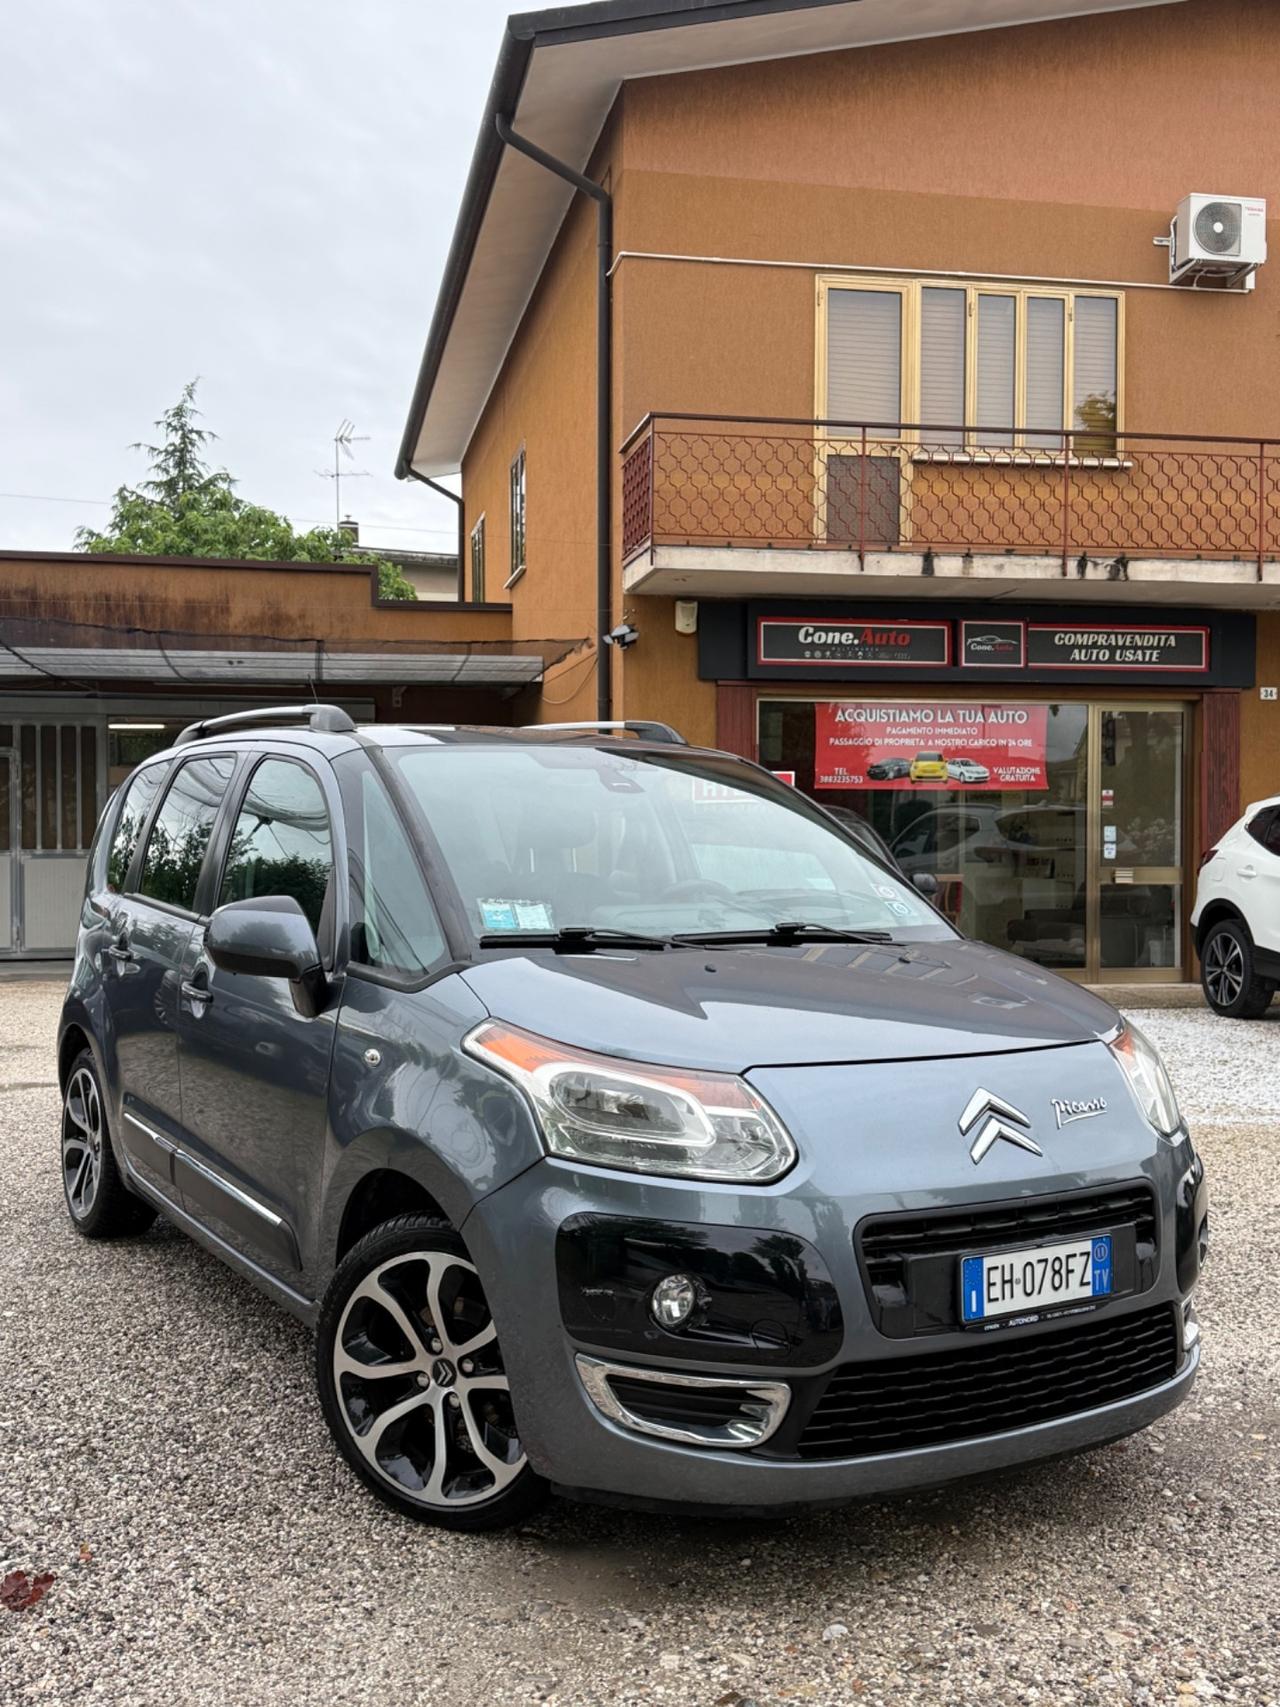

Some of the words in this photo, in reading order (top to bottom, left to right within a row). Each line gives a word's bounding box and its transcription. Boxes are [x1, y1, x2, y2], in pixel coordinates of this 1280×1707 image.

[1054, 633, 1176, 647] COMPRAVENDITA
[1070, 649, 1110, 661] AUTO
[1114, 649, 1160, 662] USATE
[1263, 689, 1274, 698] 34
[835, 708, 934, 723] ACQUISTIAMO
[937, 710, 954, 723] LA
[957, 710, 985, 723] TUA
[988, 710, 1028, 724] AUTO
[886, 726, 934, 736] PAGAMENTO
[935, 726, 978, 736] IMMEDIATO
[829, 737, 873, 746] PASSAGGIO
[874, 737, 883, 746] DI
[927, 739, 934, 747] A
[935, 738, 967, 747] NOSTRO
[968, 739, 997, 747] CARICO
[998, 739, 1007, 747] IN
[1008, 739, 1017, 747] 24
[1017, 739, 1033, 748] ORE
[993, 766, 1041, 775] VALUTAZIONE
[1000, 774, 1036, 783] GRATUITA
[1094, 1268, 1109, 1292] TV
